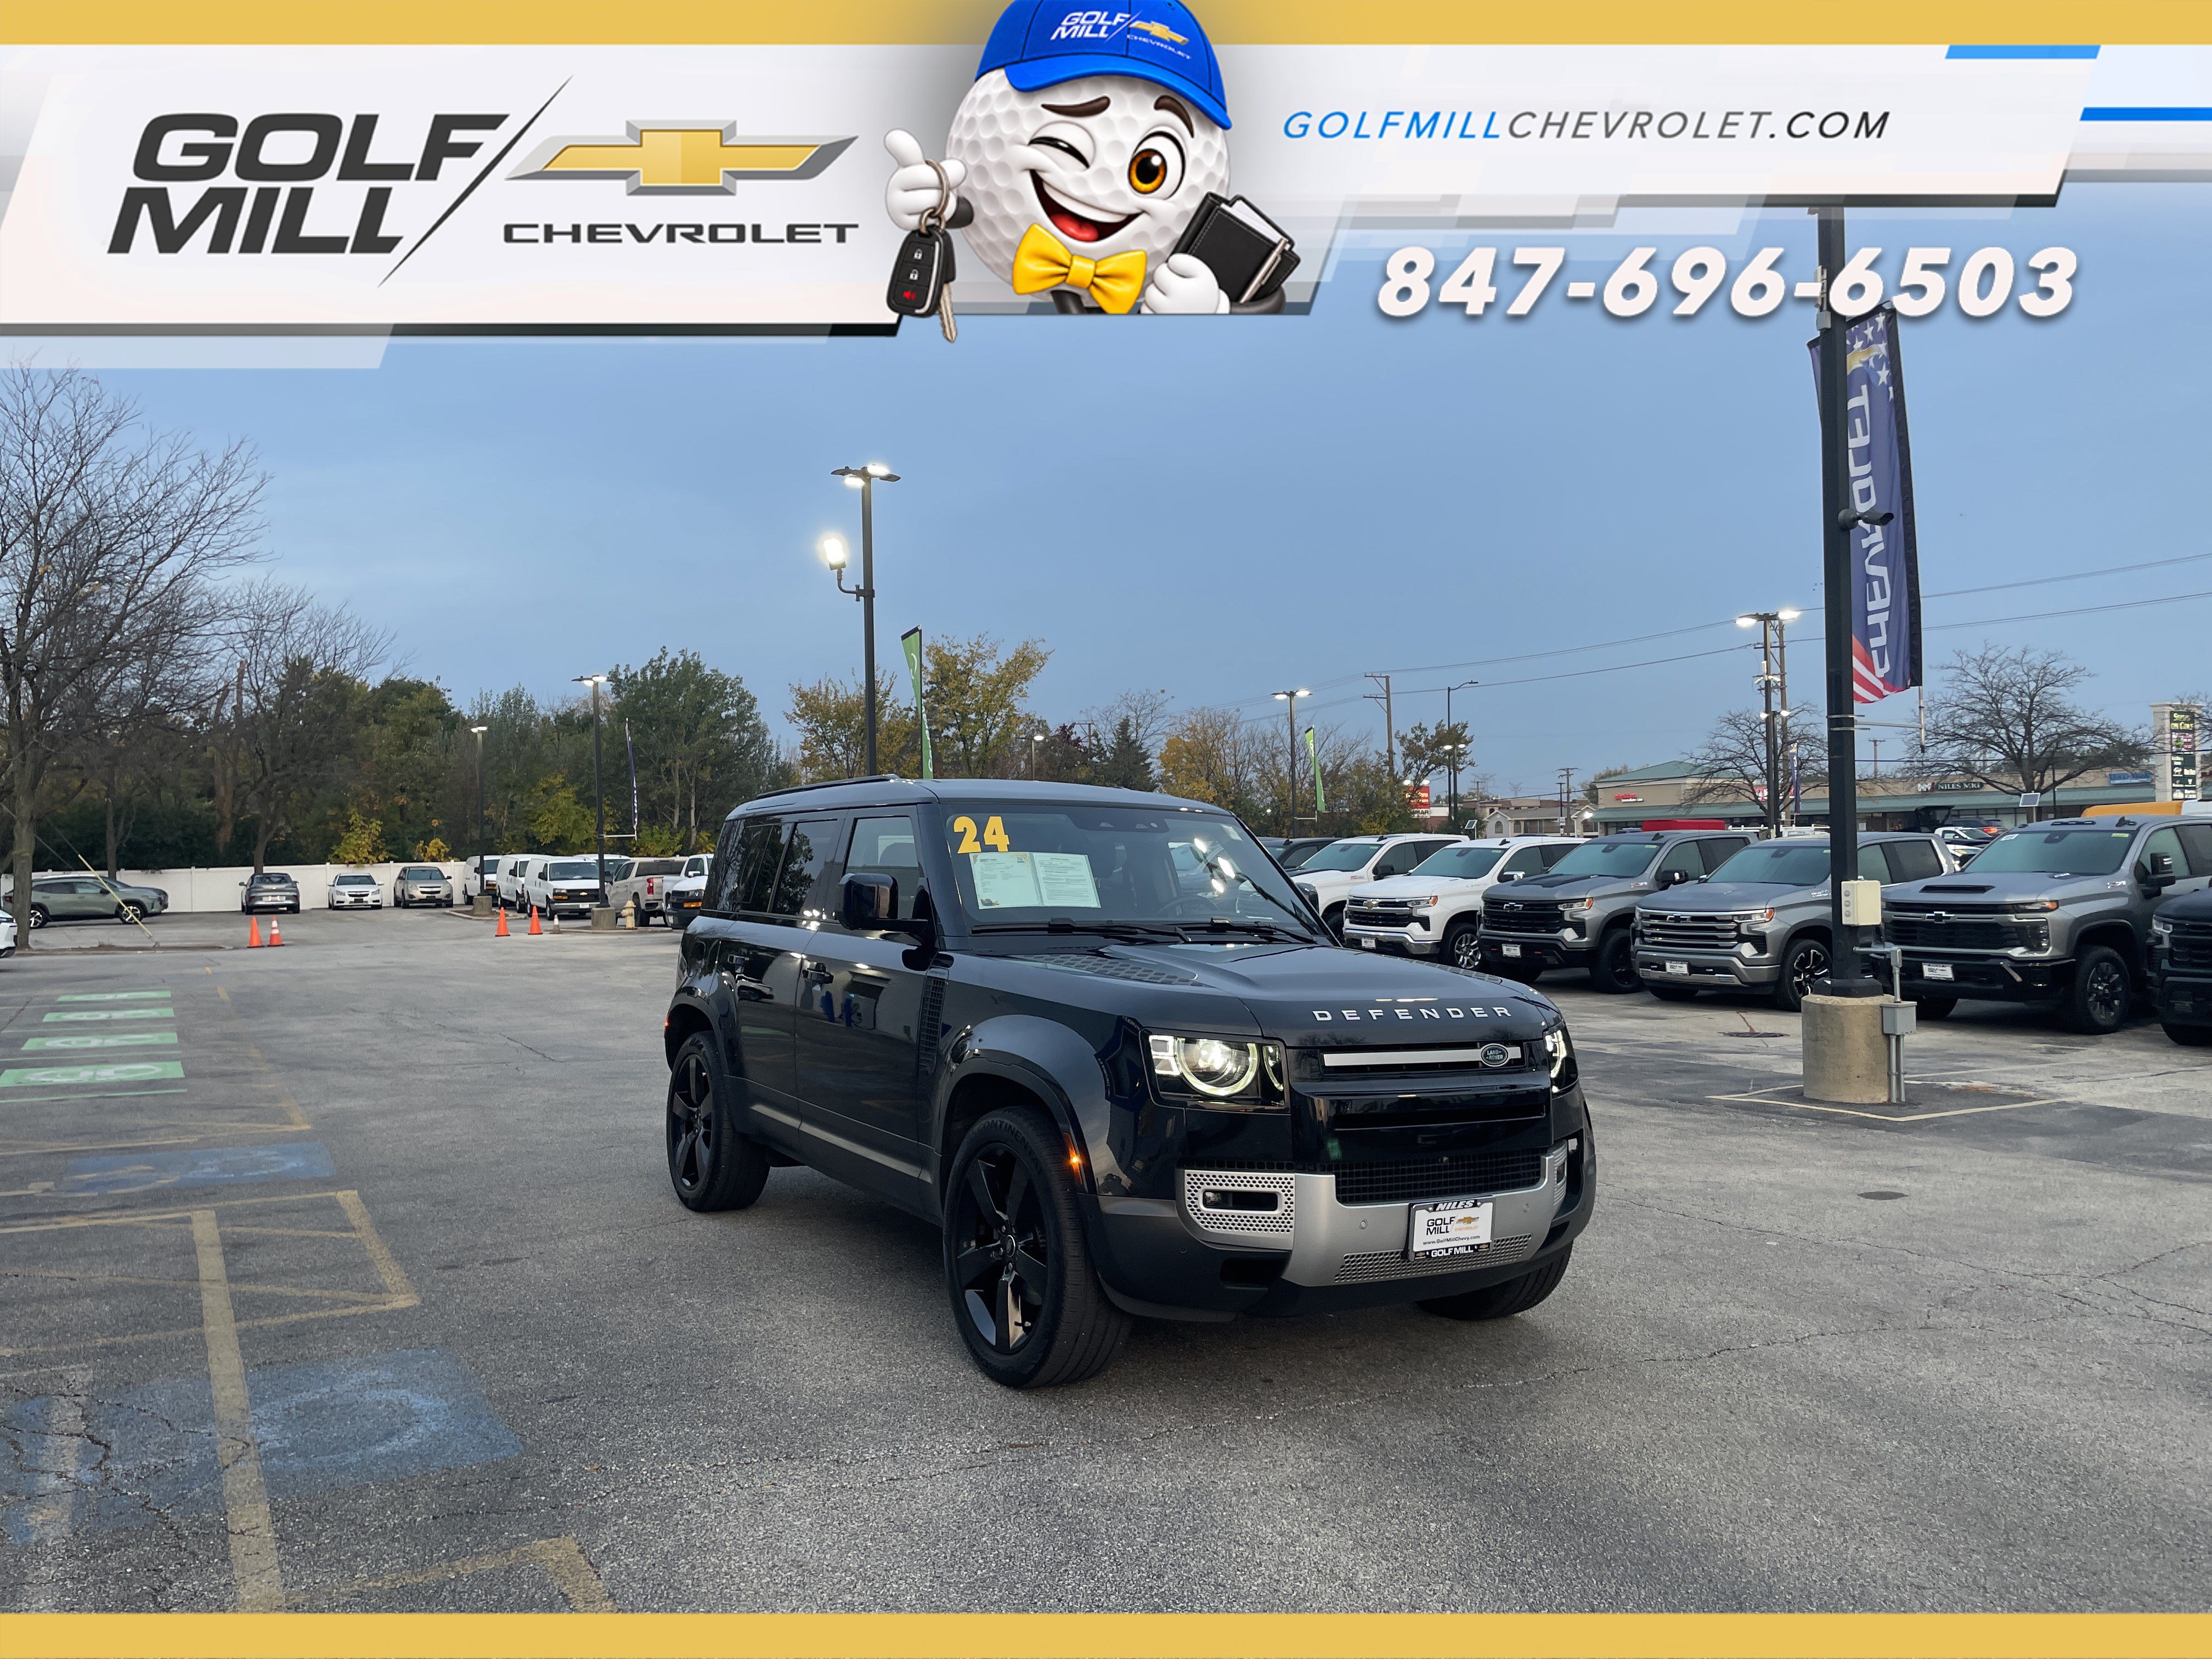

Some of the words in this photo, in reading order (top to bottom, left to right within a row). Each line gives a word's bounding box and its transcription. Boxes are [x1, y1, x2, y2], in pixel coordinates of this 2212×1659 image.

[953, 816, 1010, 854] 24
[1312, 1006, 1512, 1022] DEFENDER
[1435, 1200, 1475, 1211] NILES
[1427, 1216, 1455, 1227] GOLF
[1426, 1226, 1449, 1235] MILL
[1431, 1248, 1454, 1257] GOLF
[1453, 1245, 1474, 1255] MILL
